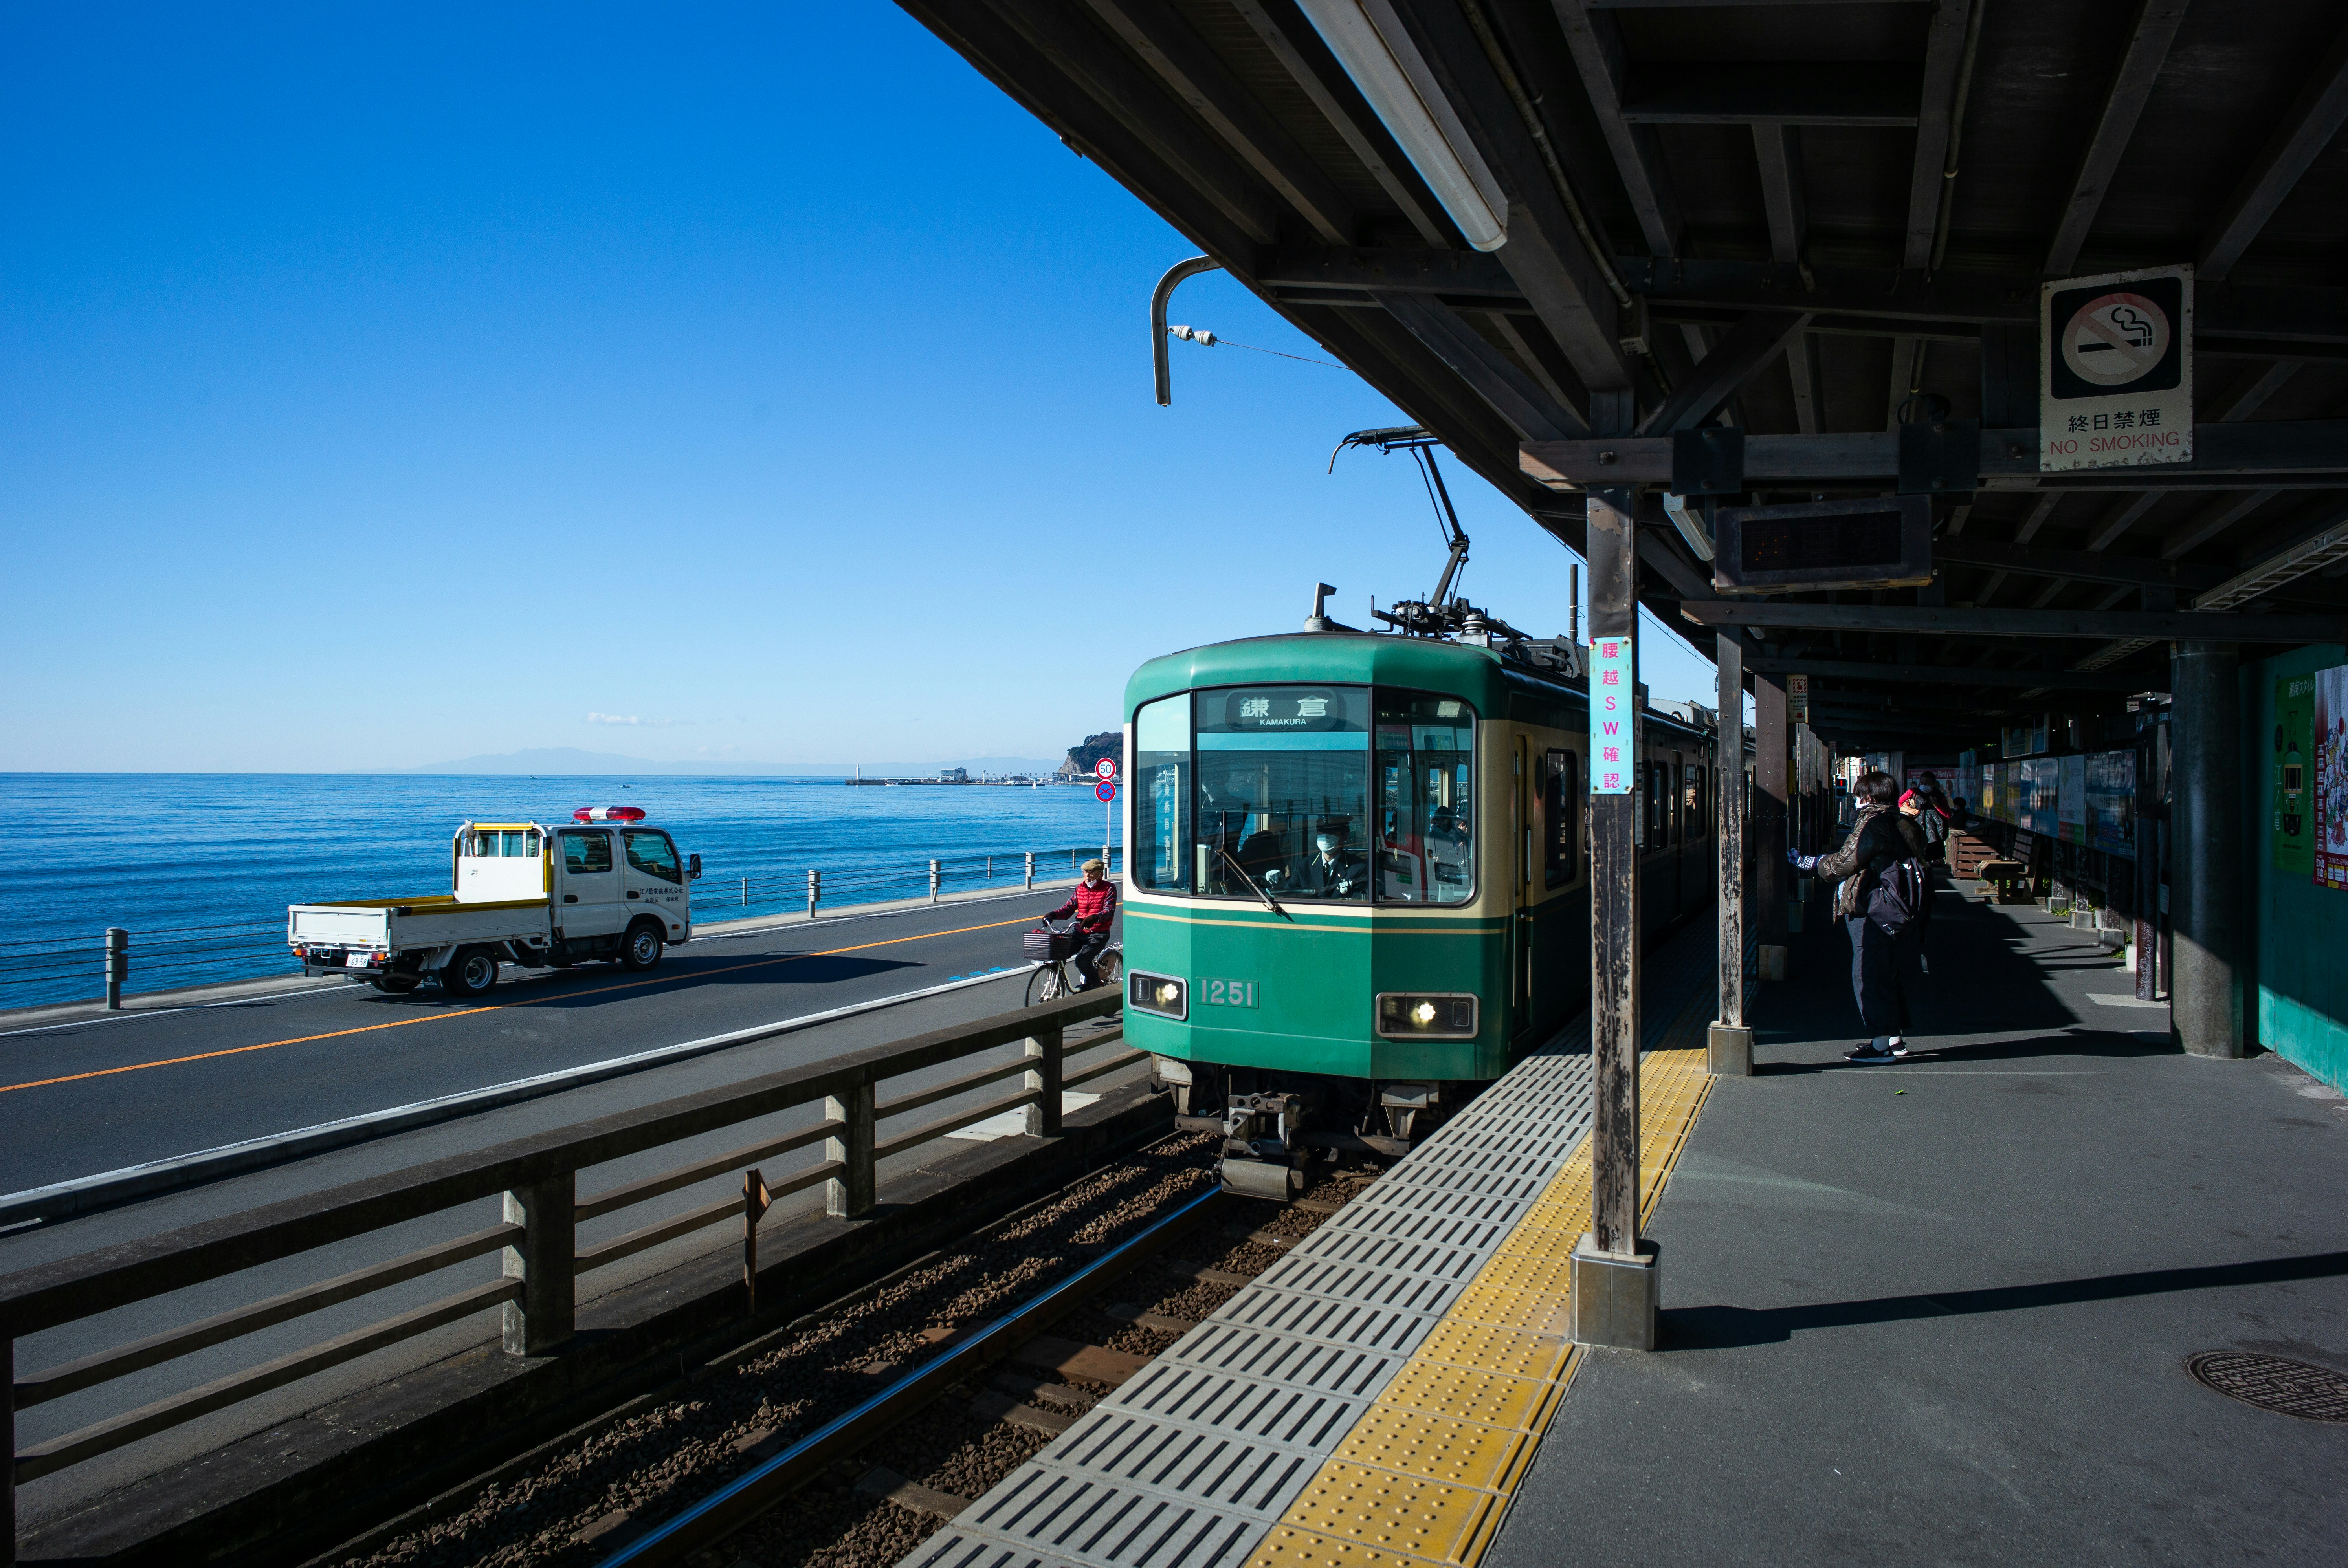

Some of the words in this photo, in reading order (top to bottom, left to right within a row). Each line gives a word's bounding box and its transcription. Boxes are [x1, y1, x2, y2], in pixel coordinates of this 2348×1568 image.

[2068, 408, 2161, 433] 終日禁煙
[2051, 440, 2078, 455] NO
[2089, 431, 2179, 452] SMOKING
[1239, 694, 1328, 717] 鎌倉
[1602, 642, 1620, 789] 腰越SW確認
[1100, 764, 1111, 773] 50
[351, 958, 367, 966] 69-58
[1202, 979, 1252, 1006] 1251
